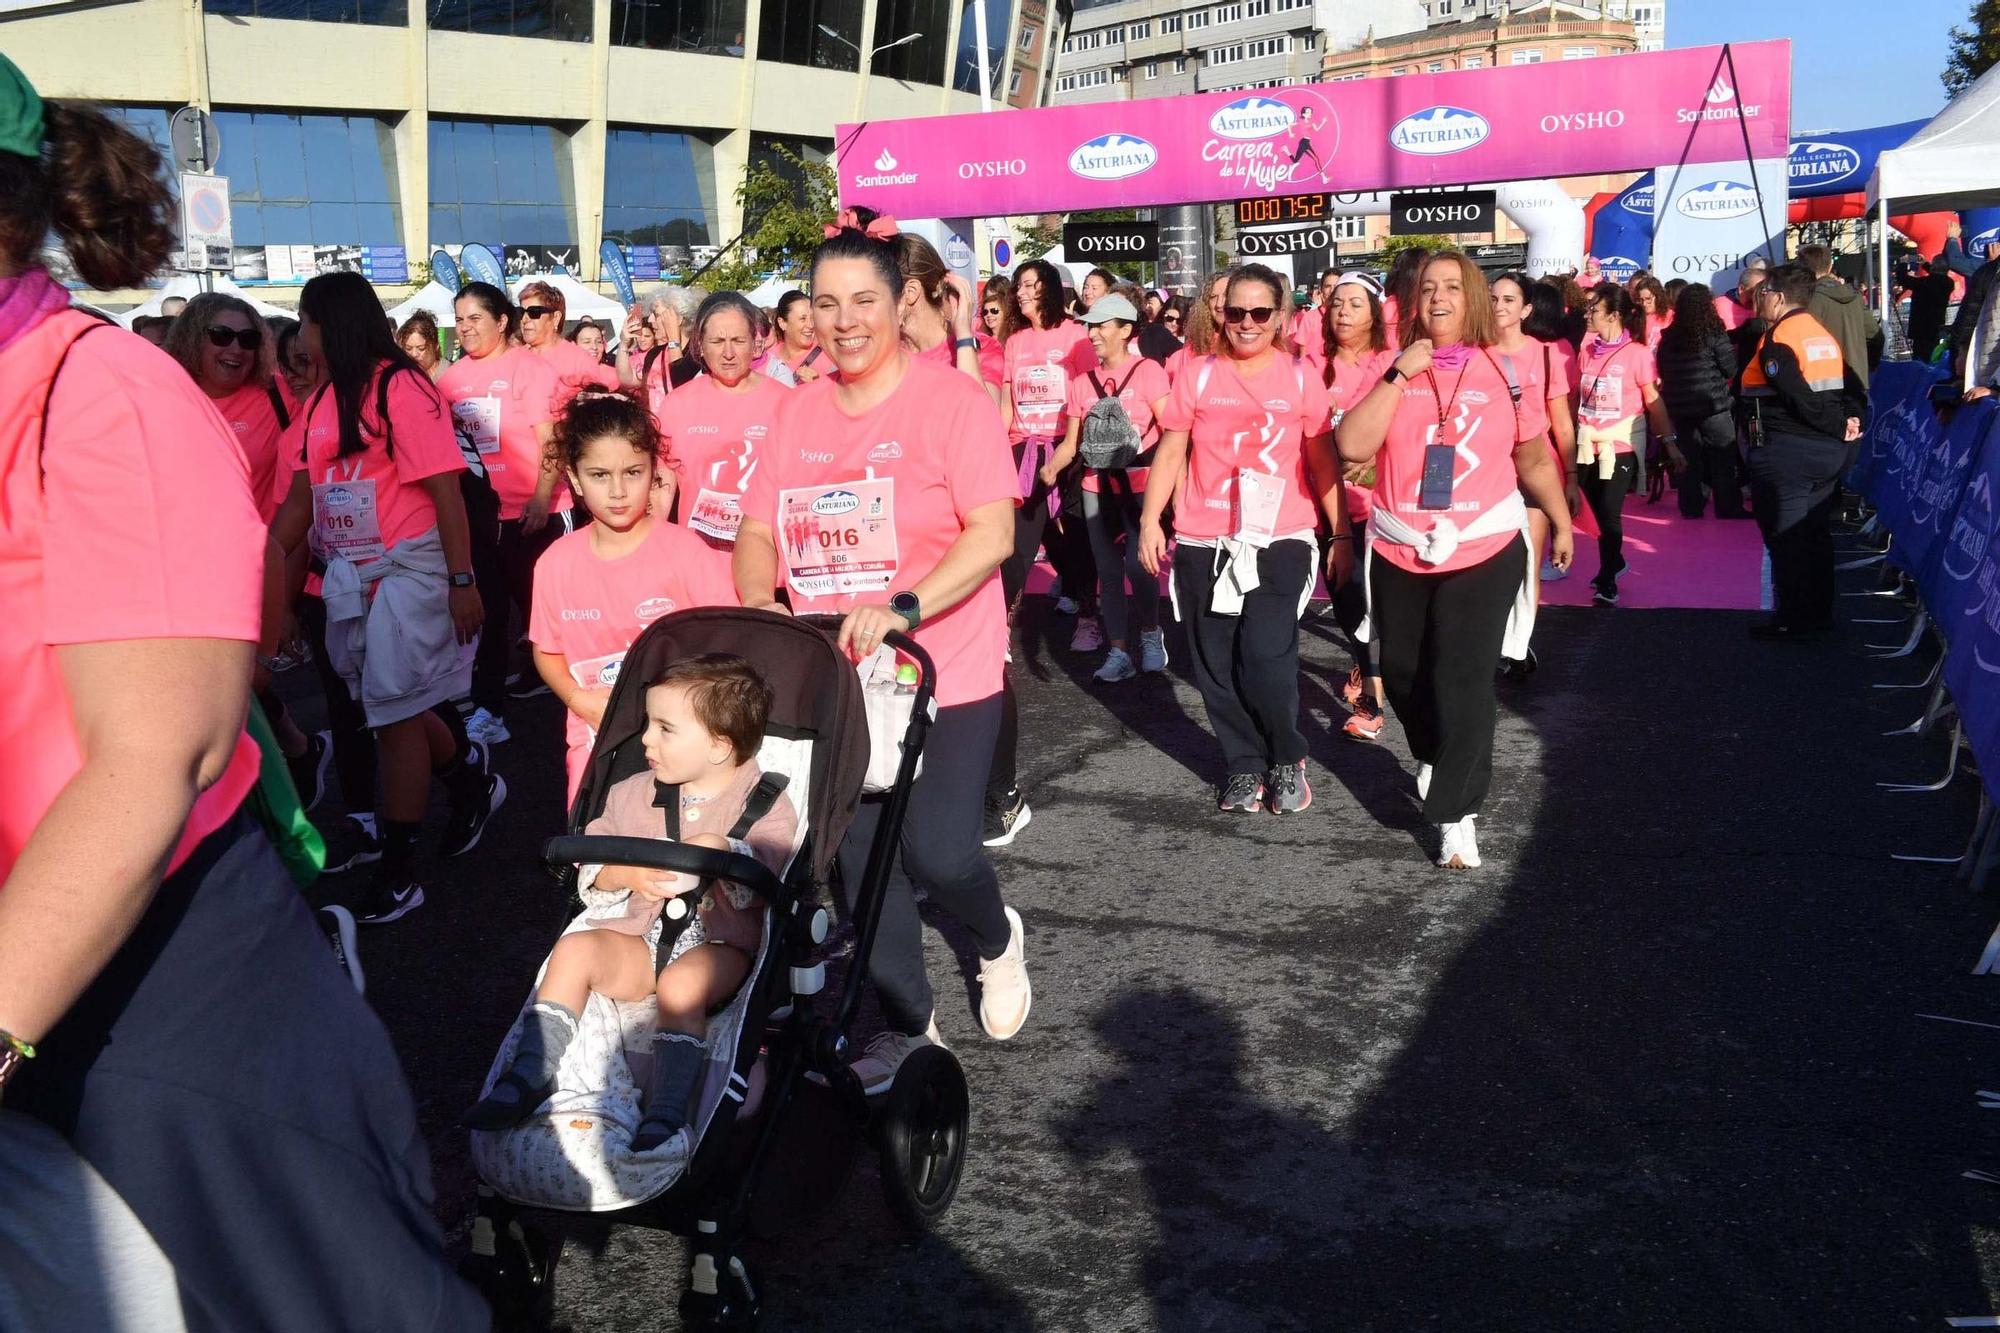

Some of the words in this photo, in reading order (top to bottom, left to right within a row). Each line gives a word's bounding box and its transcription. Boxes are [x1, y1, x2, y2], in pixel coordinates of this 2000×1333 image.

[1540, 109, 1625, 133] OYSHO
[1676, 103, 1761, 123] Santander
[1216, 114, 1289, 131] ASTURIANA
[1397, 126, 1481, 145] ASTURIANA
[1202, 139, 1274, 161] Carrera
[958, 159, 1026, 179] OYSHO
[1076, 153, 1151, 170] ASTURIANA
[1789, 159, 1851, 177] URIANA
[855, 171, 919, 188] Santander
[1219, 162, 1233, 177] de
[1236, 160, 1246, 176] la
[1244, 153, 1300, 191] Mujer
[1240, 195, 1323, 223] 00:07:52
[1509, 199, 1553, 209] OYSHO
[1682, 197, 1757, 212] ASTURIANA
[1405, 204, 1481, 223] OYSHO
[1078, 235, 1146, 251] OYSHO
[1241, 229, 1329, 254] OYSHO
[1531, 257, 1572, 268] OYSHO
[1672, 251, 1762, 273] OYSHO
[1031, 385, 1048, 393] 016
[800, 449, 834, 464] YSHO
[814, 499, 856, 511] ASTURIANA
[328, 515, 354, 529] 016
[818, 528, 859, 548] 016
[831, 555, 848, 563] 806
